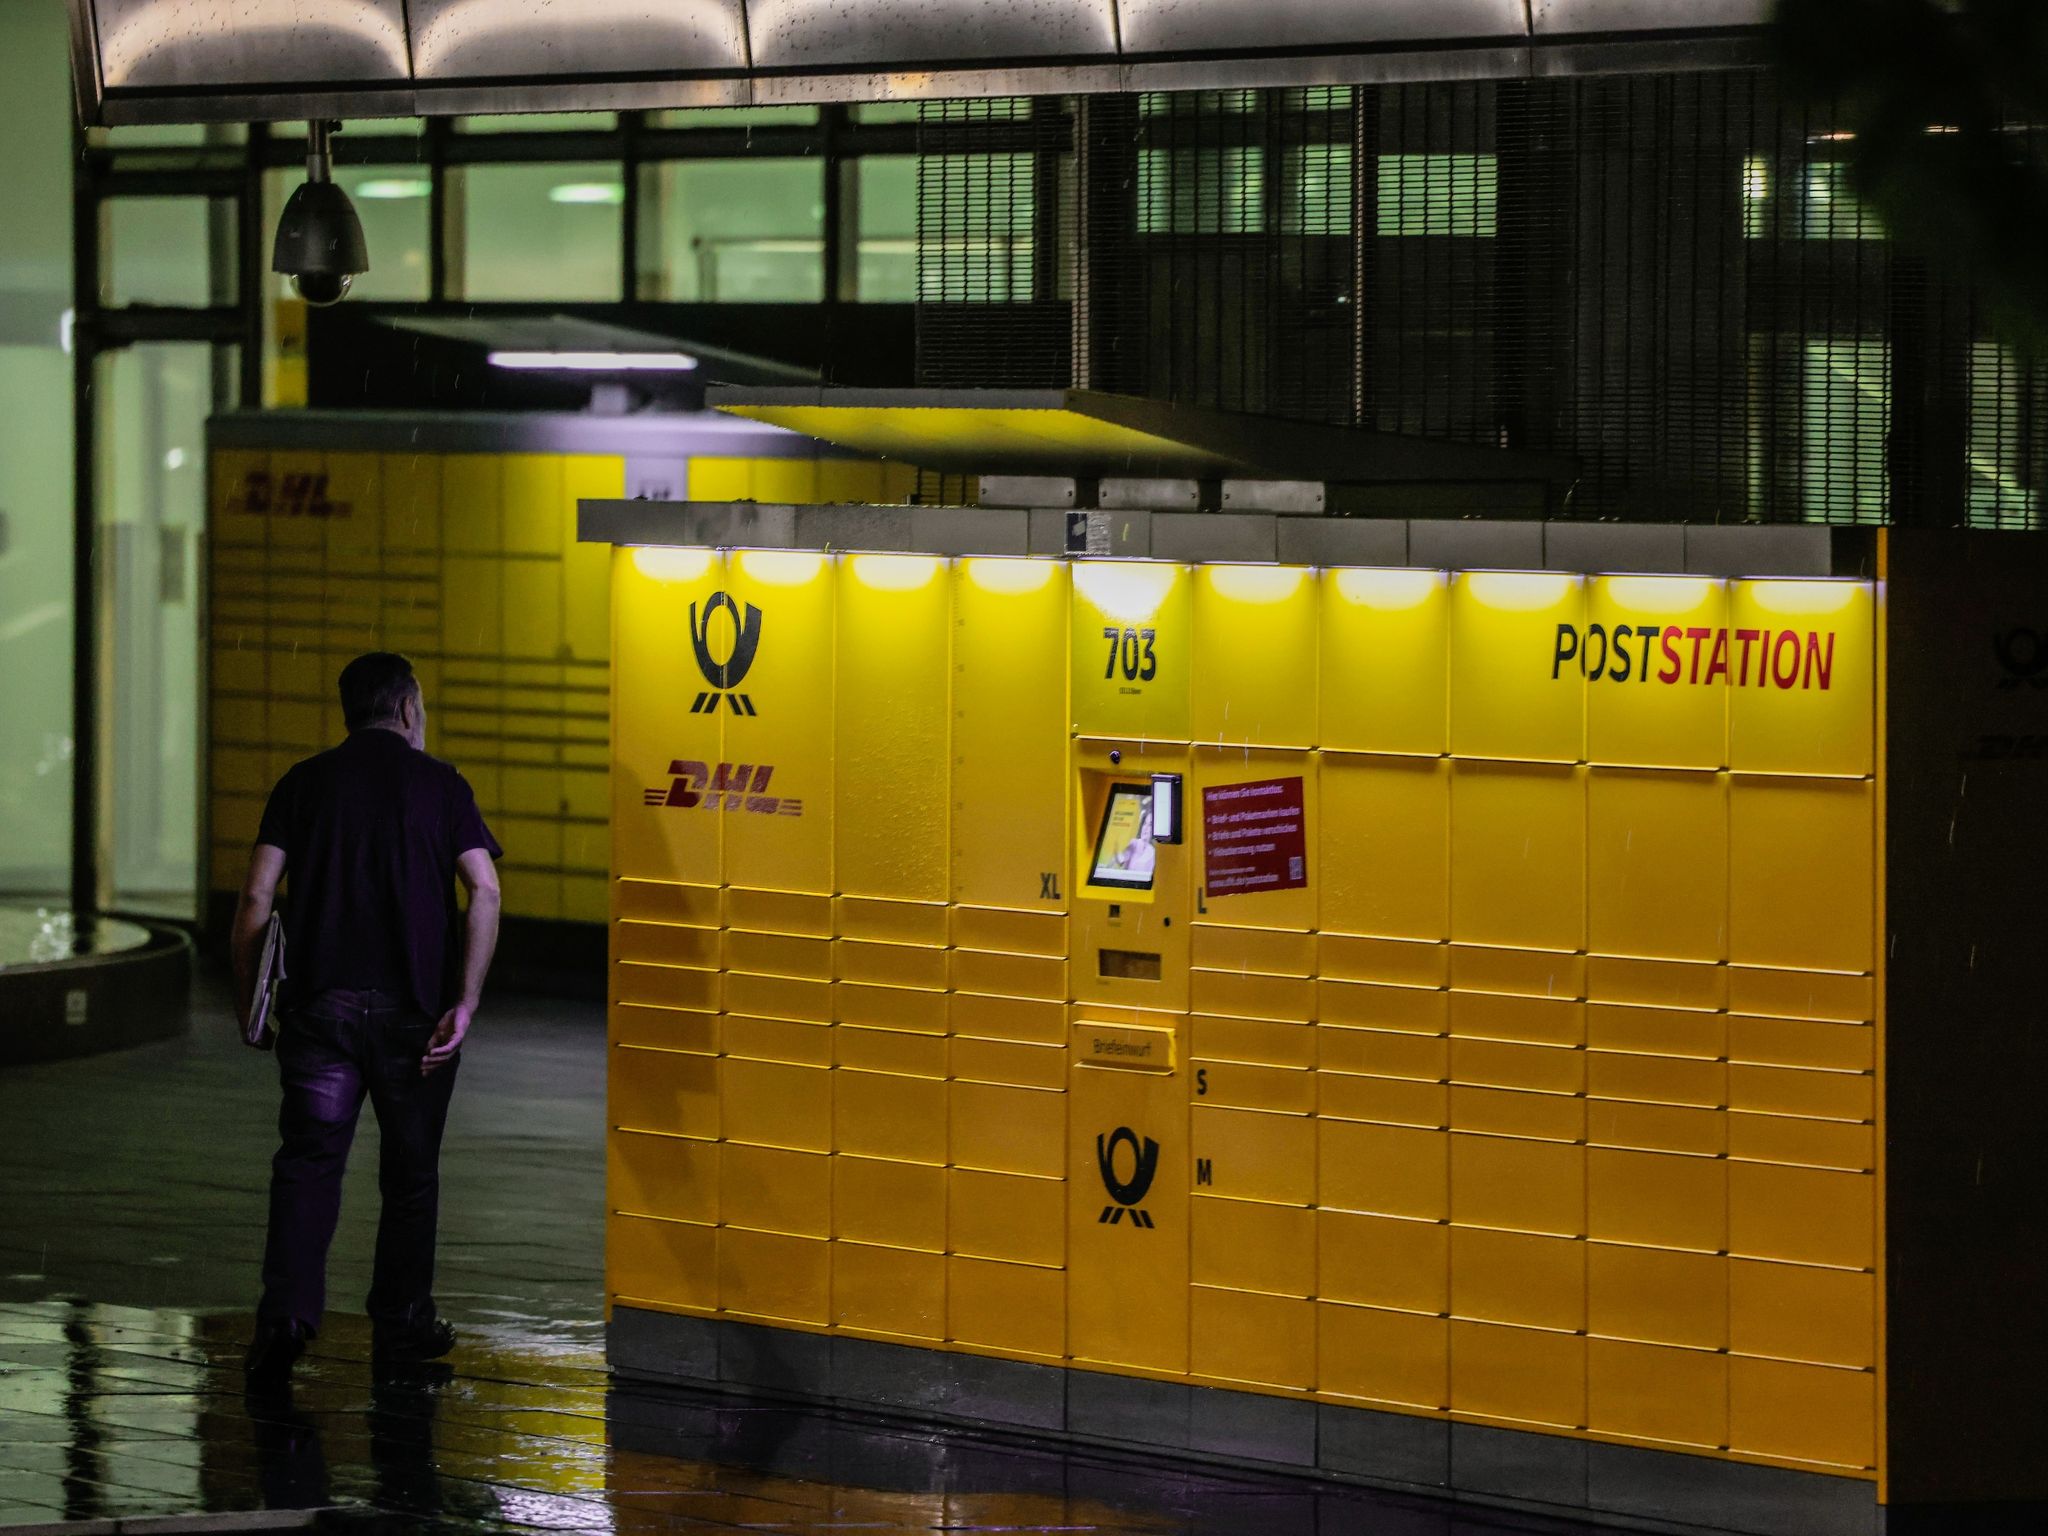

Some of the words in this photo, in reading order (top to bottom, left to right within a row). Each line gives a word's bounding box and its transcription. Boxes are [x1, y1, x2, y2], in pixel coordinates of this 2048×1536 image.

[1103, 628, 1156, 681] 703
[1552, 624, 1836, 690] POSTSTATION
[665, 760, 782, 814] DHL
[1040, 872, 1061, 900] XL
[1196, 1068, 1208, 1096] S
[1196, 1157, 1212, 1187] M
